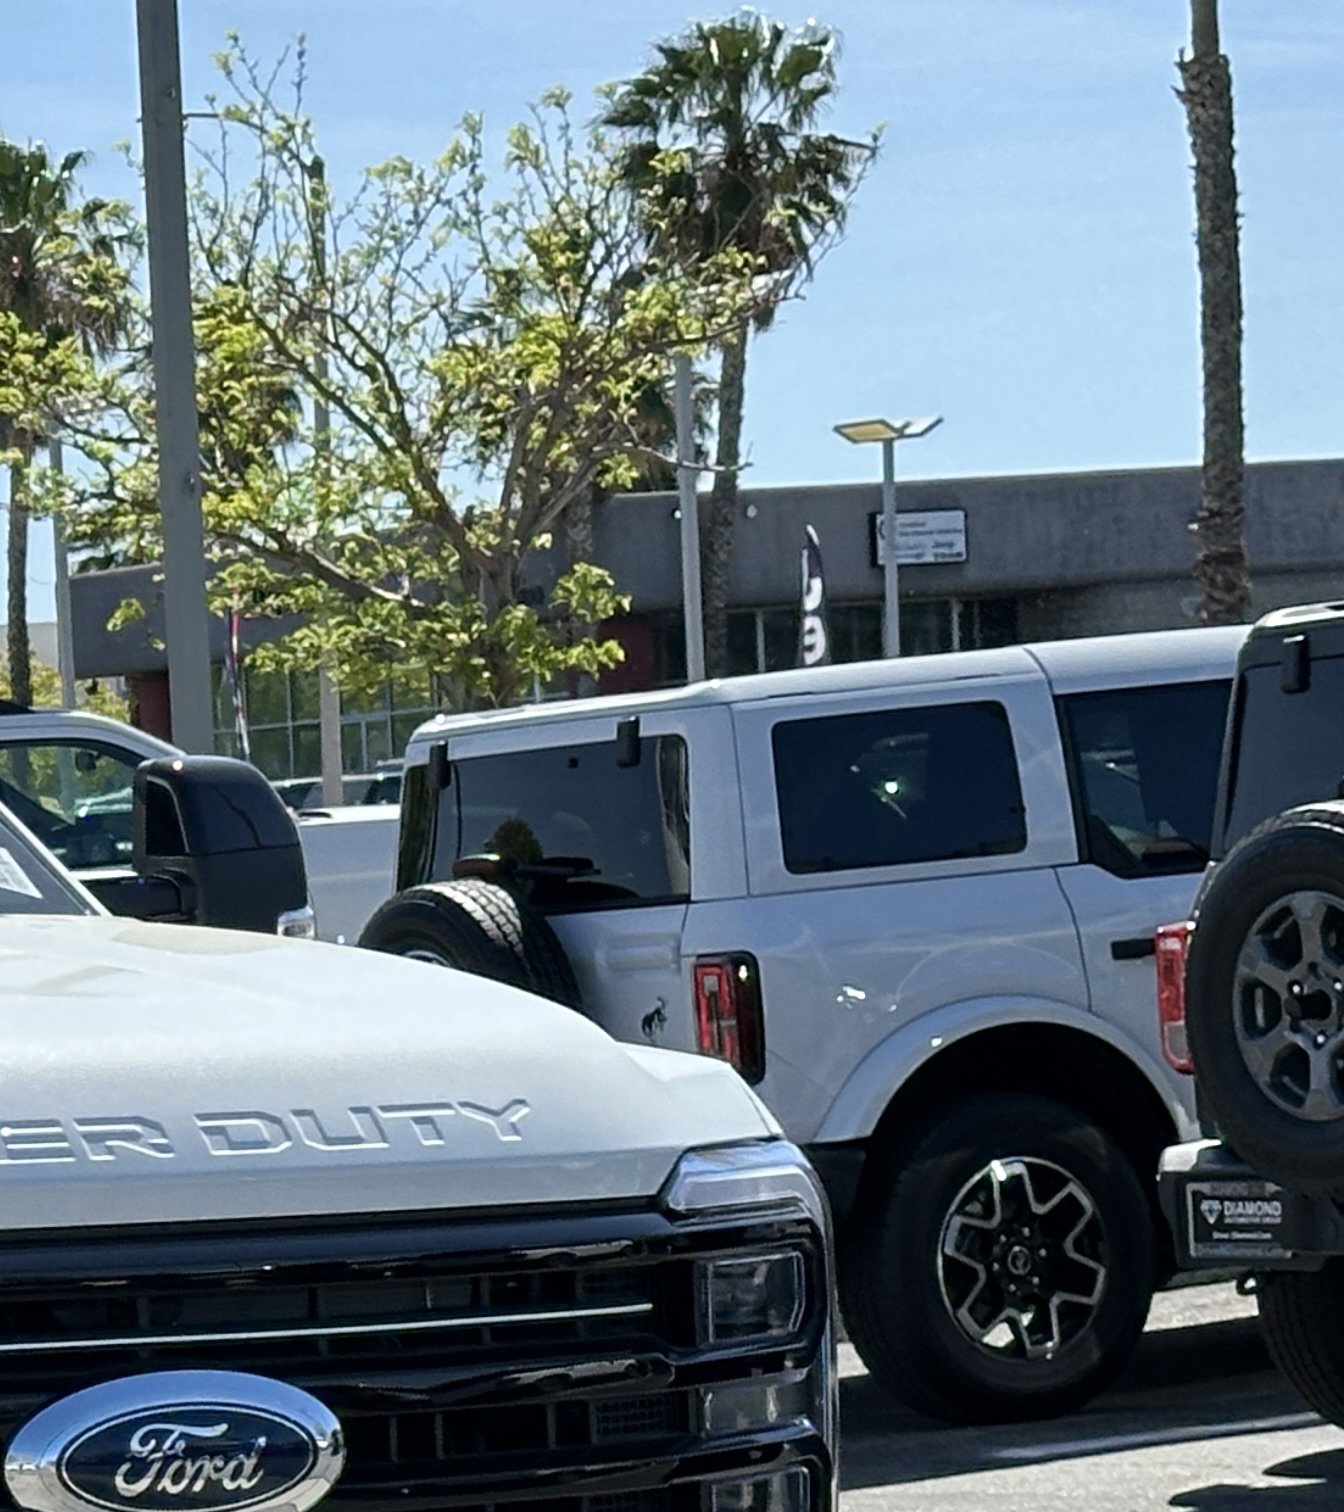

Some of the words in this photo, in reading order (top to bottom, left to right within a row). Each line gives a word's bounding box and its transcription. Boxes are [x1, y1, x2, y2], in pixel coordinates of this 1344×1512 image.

[194, 1097, 531, 1157] DUTY
[1223, 1200, 1282, 1216] DIAMOND
[115, 1422, 267, 1497] Ford
